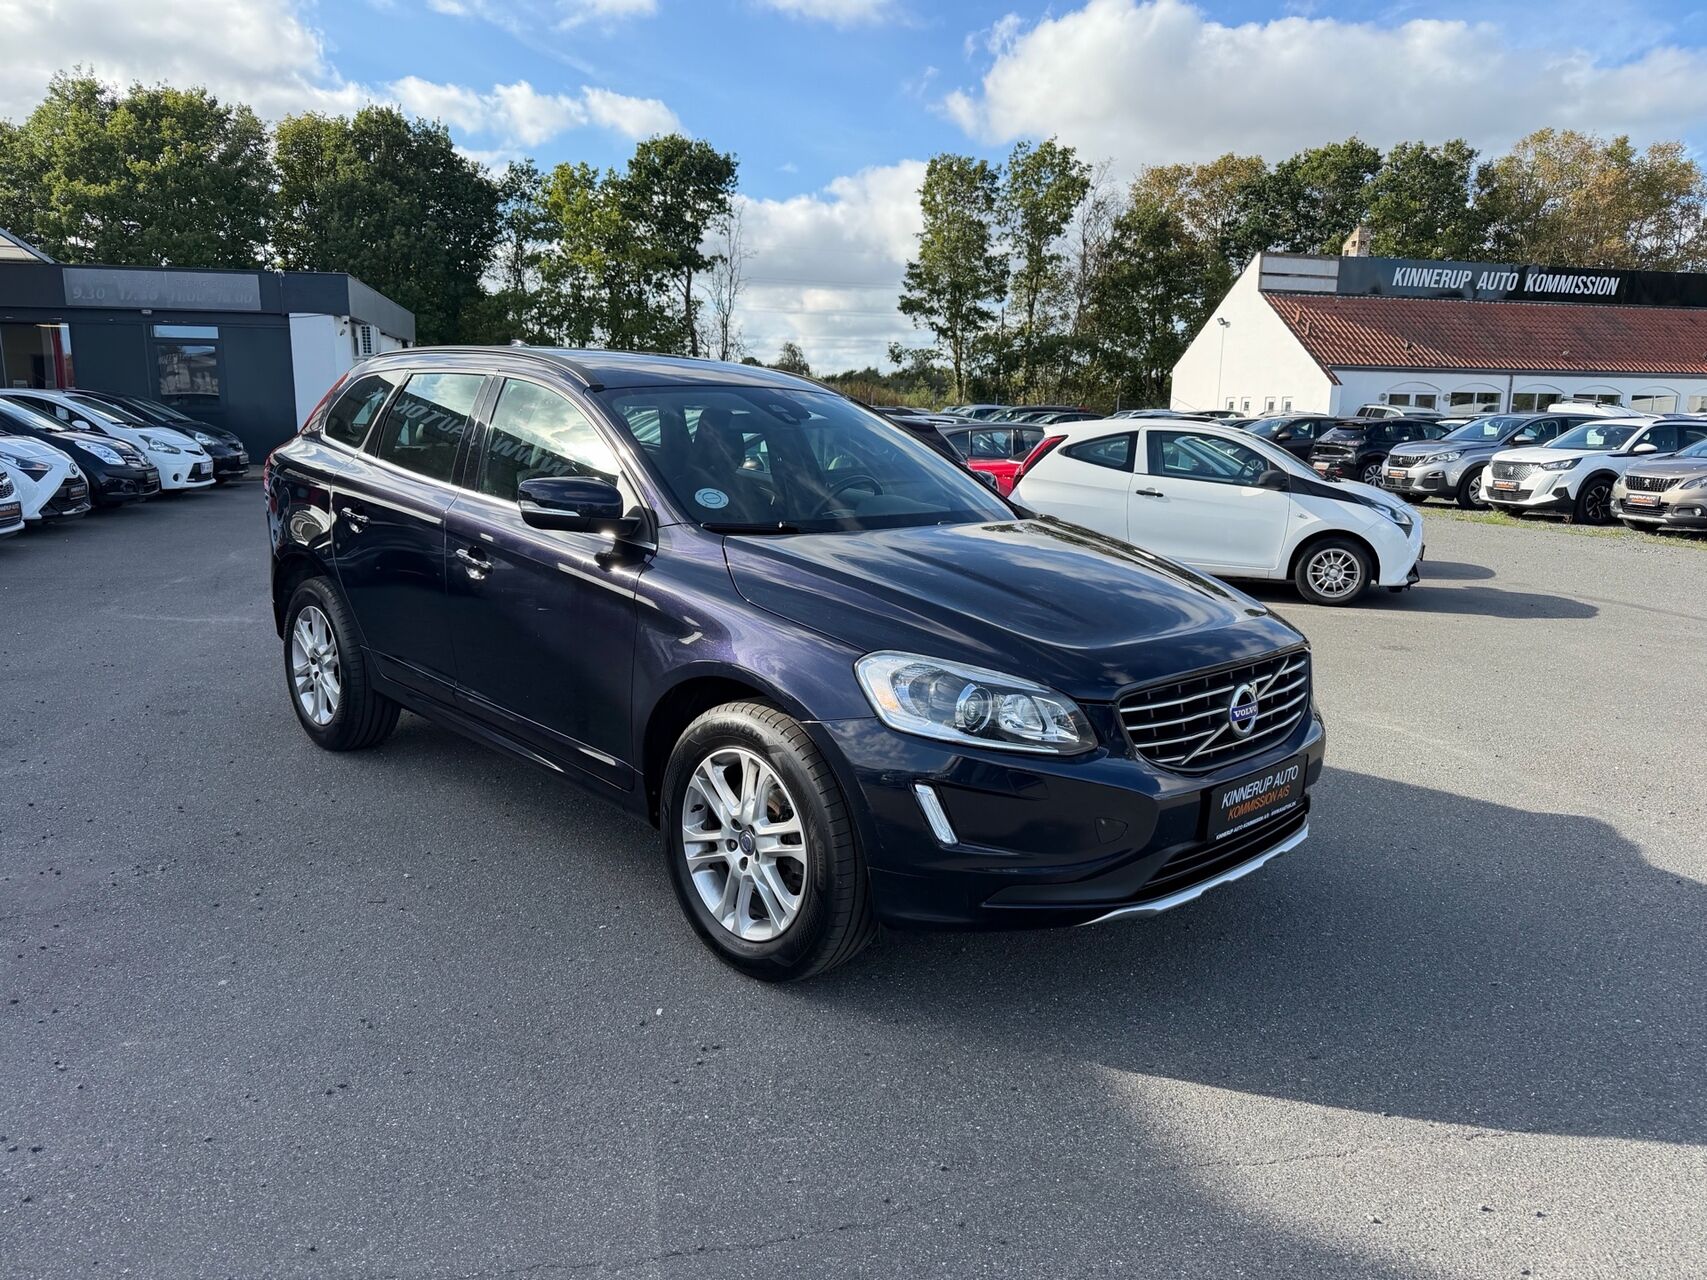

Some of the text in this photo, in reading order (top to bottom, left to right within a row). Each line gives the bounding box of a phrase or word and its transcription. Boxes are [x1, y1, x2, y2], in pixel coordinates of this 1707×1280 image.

[72, 287, 105, 300] 9.30
[1392, 267, 1620, 295] KINNERUP AUTO KOMMISSION
[1233, 704, 1258, 718] VOLVO
[1221, 776, 1273, 809] KINNERUP
[1272, 765, 1299, 789] AUTO
[1227, 790, 1279, 821] KOMMISSION
[1276, 785, 1291, 800] A/S
